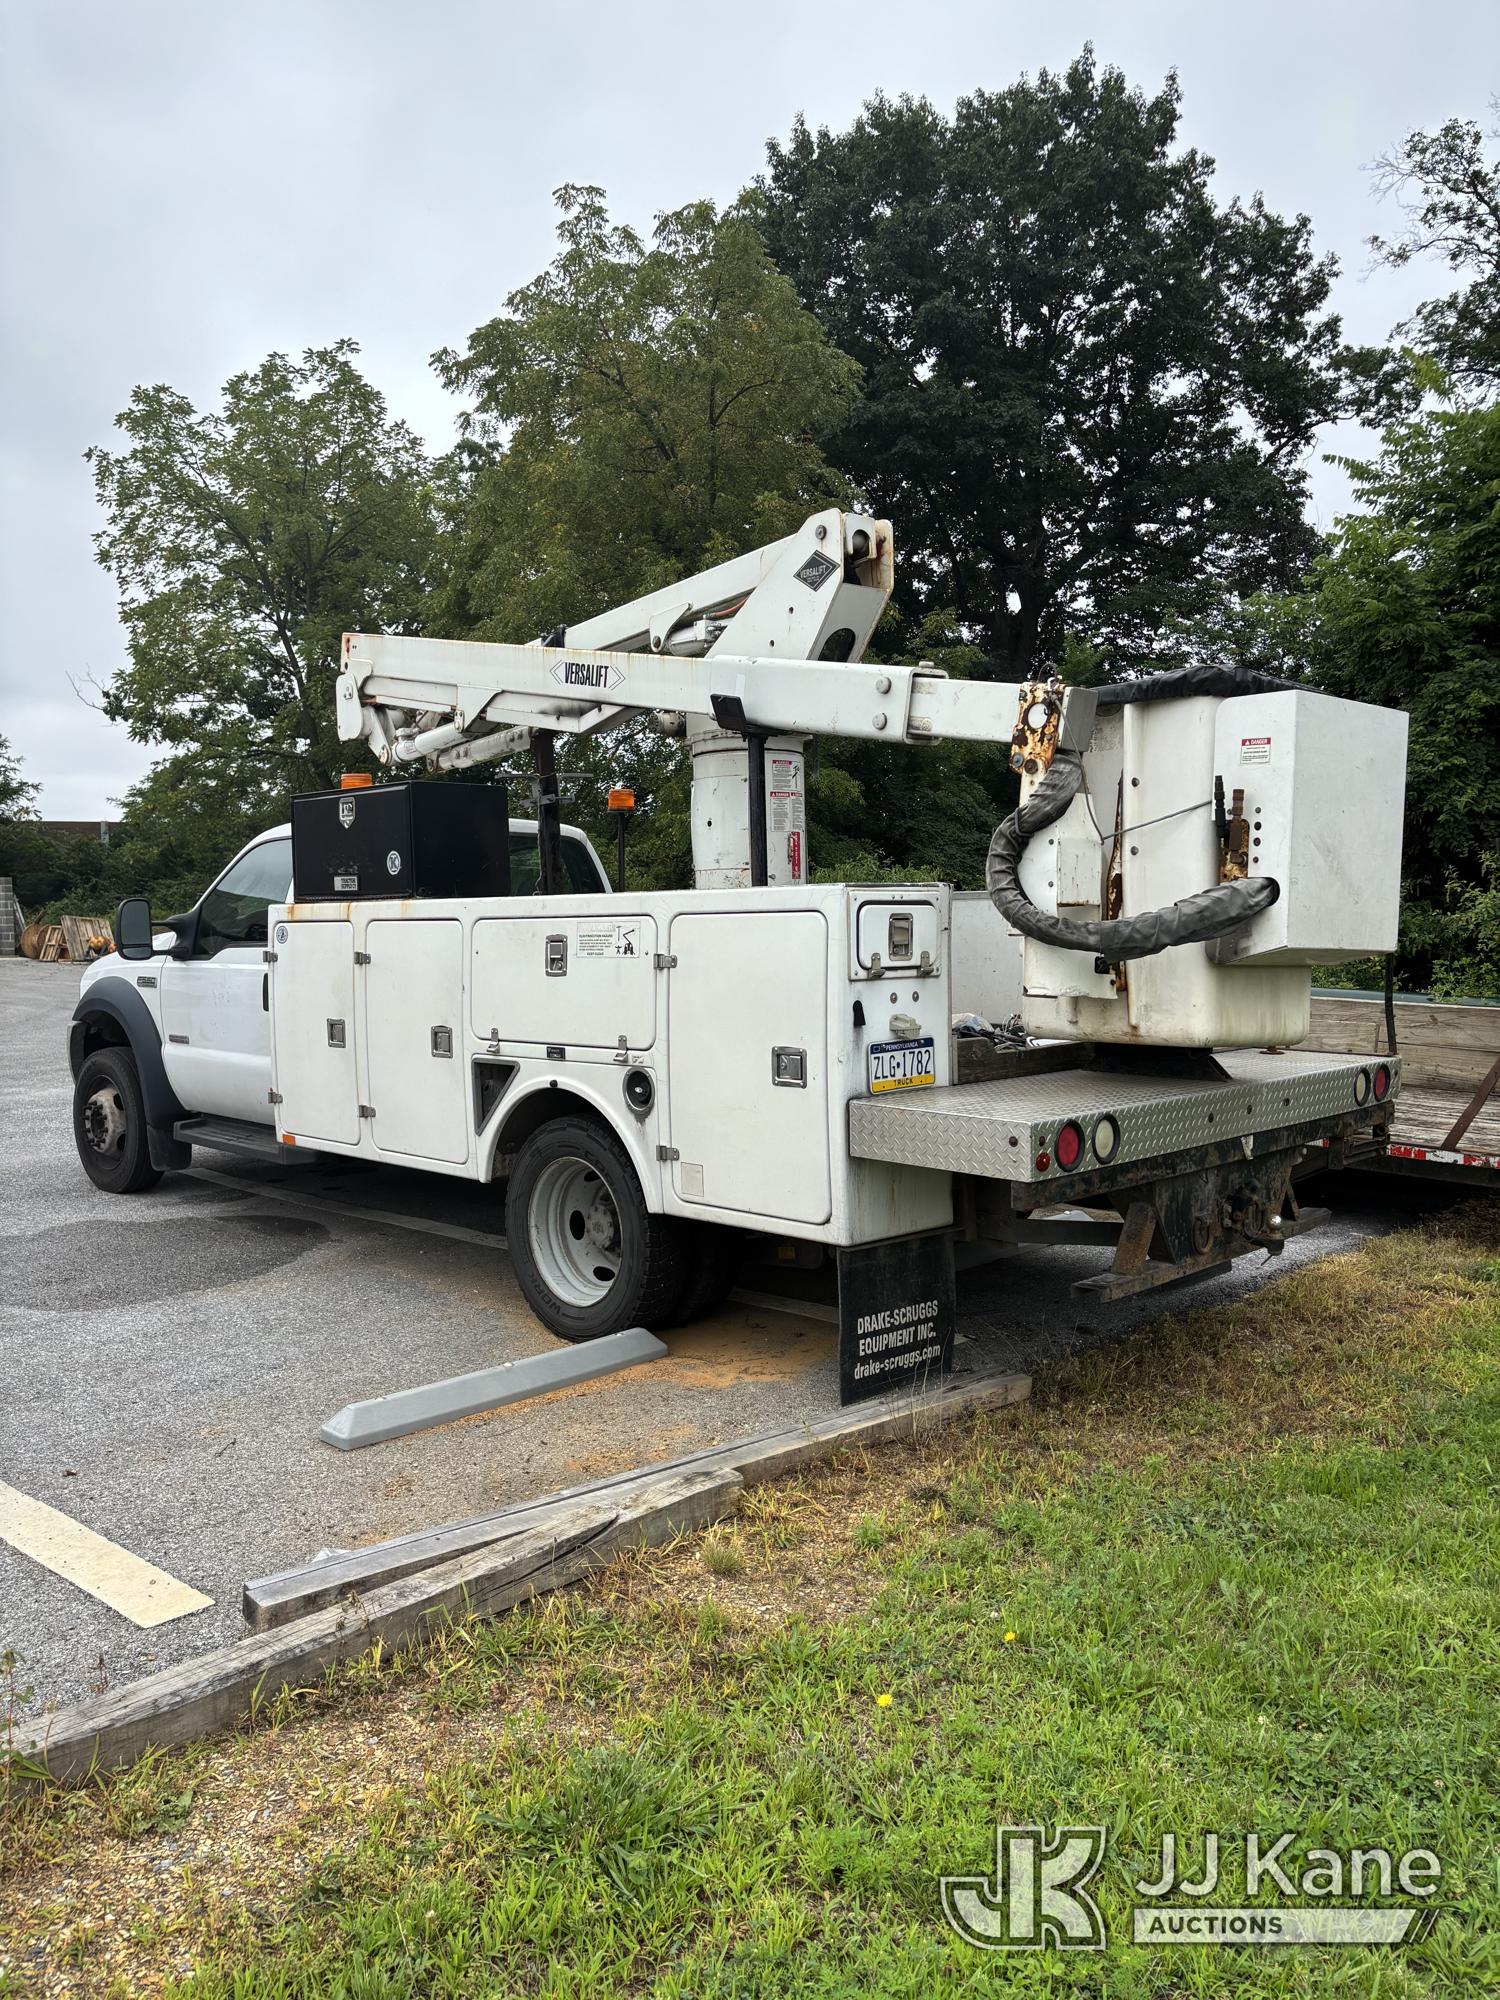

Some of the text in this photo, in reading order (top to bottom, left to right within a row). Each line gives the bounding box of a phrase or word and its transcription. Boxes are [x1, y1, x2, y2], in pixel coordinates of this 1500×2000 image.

[564, 661, 609, 688] VERSALIFT
[885, 1041, 919, 1051] PENNSYLVANIA
[894, 1077, 914, 1087] TRUCK
[857, 1299, 939, 1335] DRAKE-SCRUGGS
[859, 1322, 937, 1357] EQUIPMENT INC.
[854, 1344, 941, 1380] drake-scruggs.com
